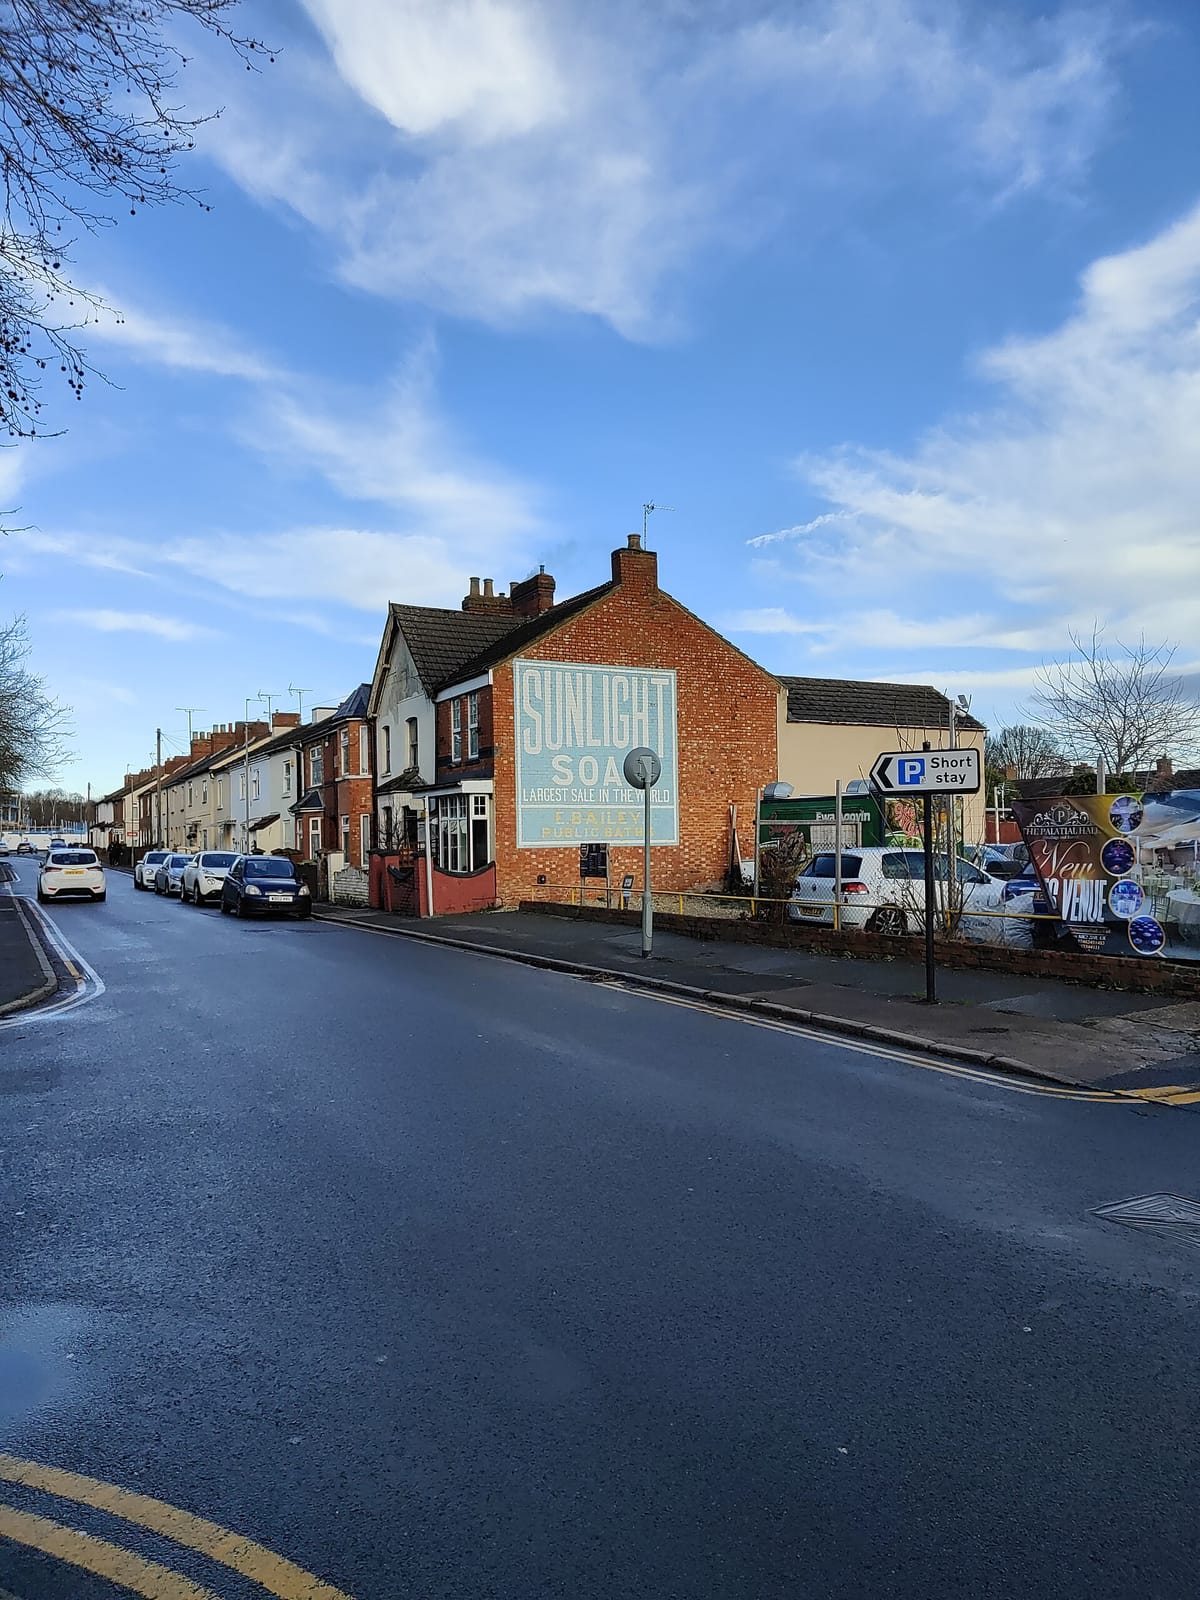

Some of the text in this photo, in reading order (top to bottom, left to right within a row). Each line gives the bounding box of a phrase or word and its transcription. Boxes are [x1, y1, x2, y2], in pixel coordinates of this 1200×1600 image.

[522, 669, 670, 759] SUNLIGHT
[551, 755, 623, 787] SOA
[905, 756, 972, 783] P Short
[935, 772, 967, 785] stay
[523, 788, 670, 803] LARGEST SALE IN THE WRLD
[815, 811, 836, 821] Ewa
[541, 826, 600, 839] PUBLIC
[1040, 827, 1078, 836] PALATIAL
[1029, 840, 1095, 878] New
[1061, 878, 1108, 923] VENUE
